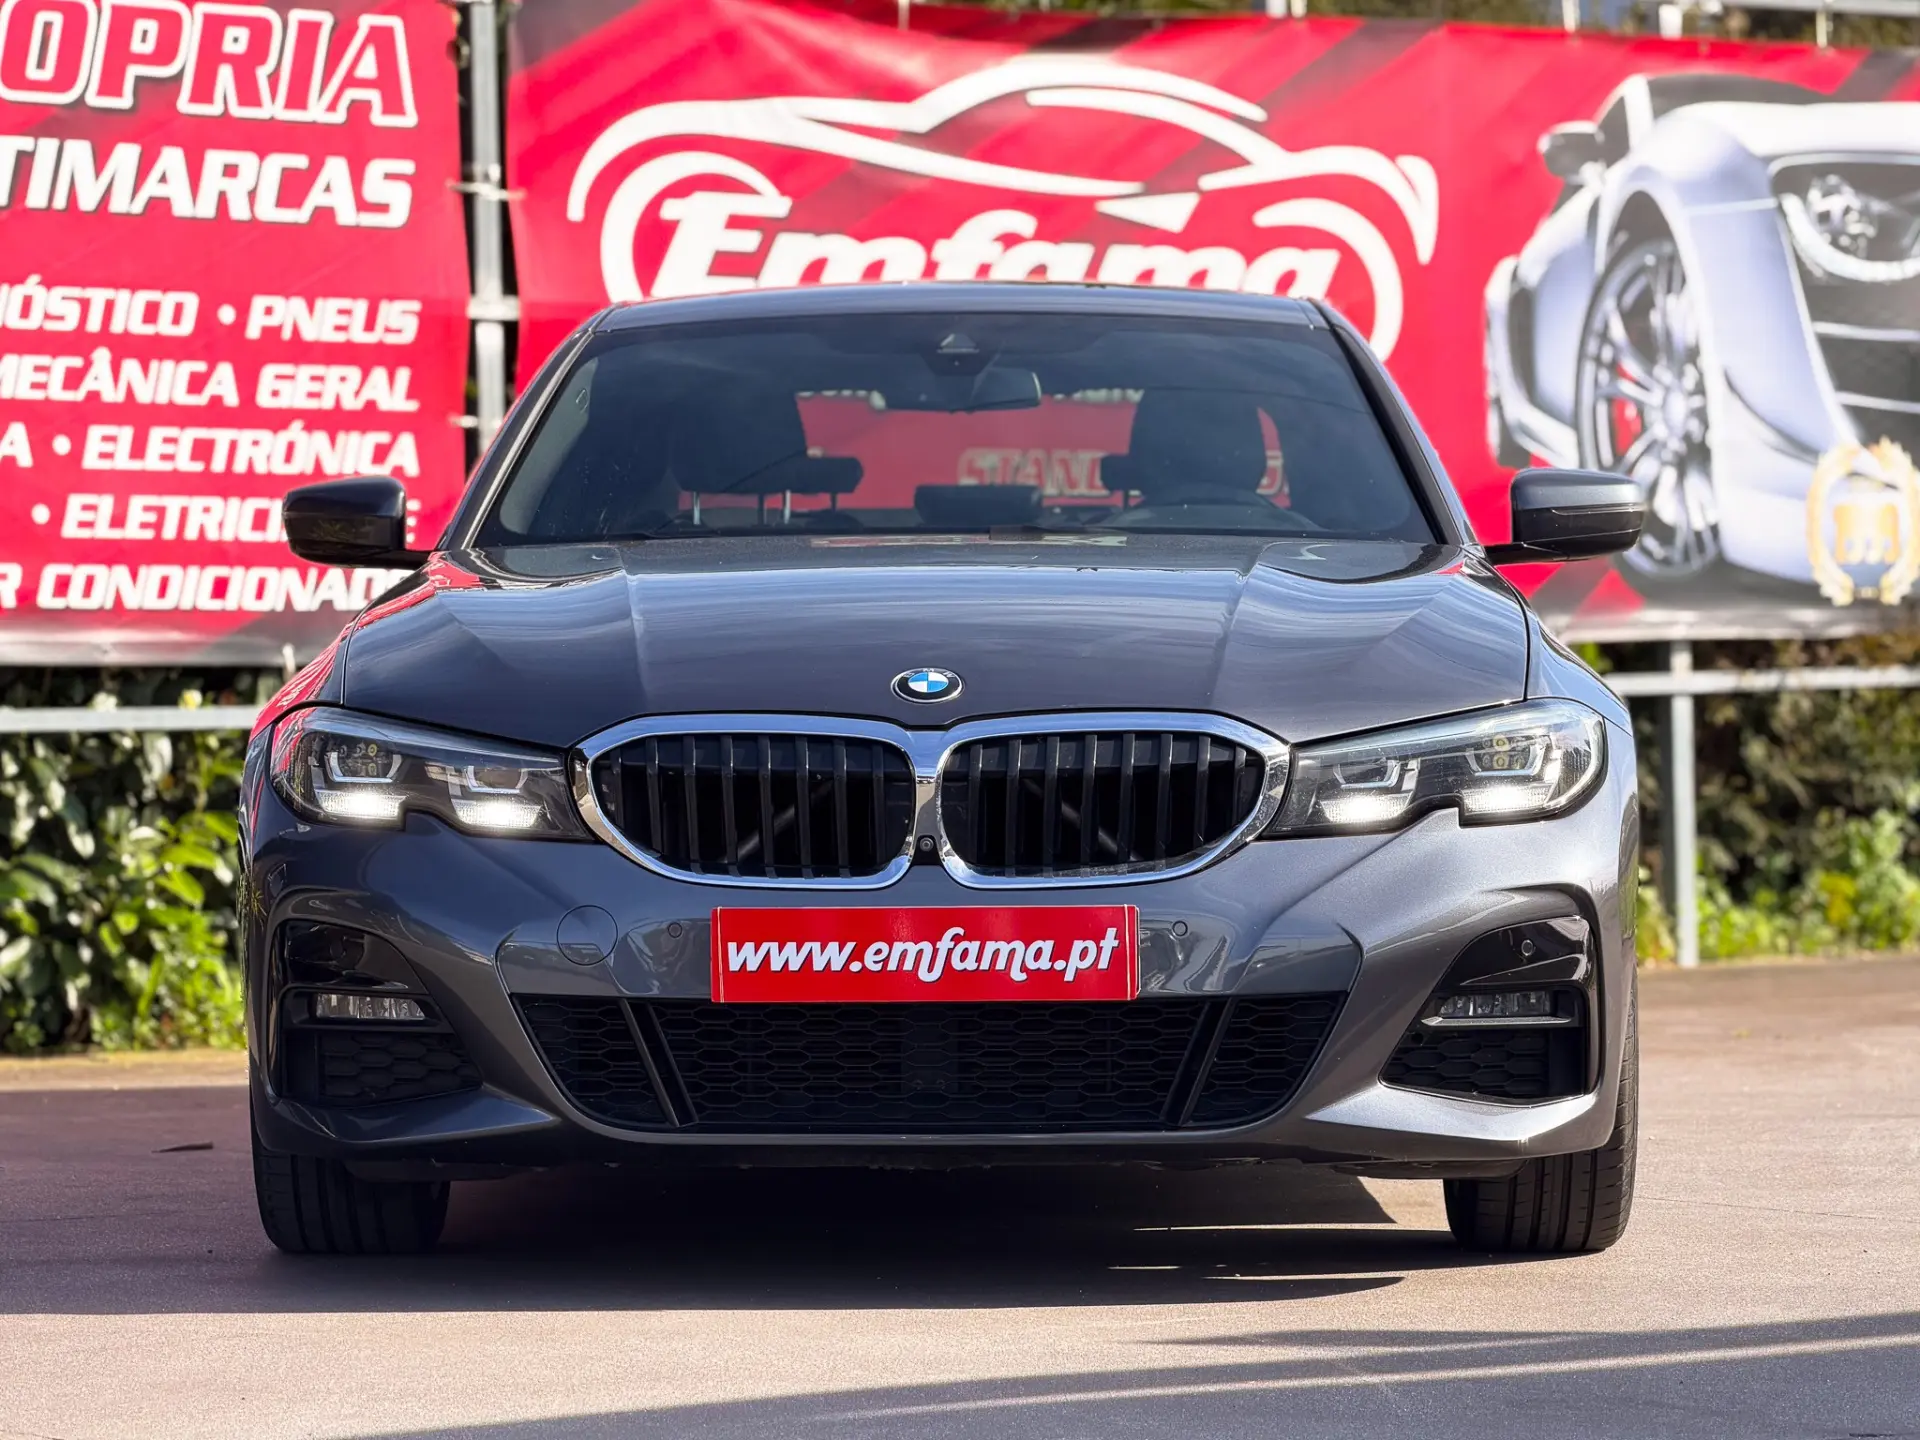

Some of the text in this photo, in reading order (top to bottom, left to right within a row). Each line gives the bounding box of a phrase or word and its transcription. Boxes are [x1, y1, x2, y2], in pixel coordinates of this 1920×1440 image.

[0, 0, 419, 129] OPRIA
[650, 190, 1342, 299] Emfama
[245, 294, 422, 345] PNEUS
[255, 362, 420, 412] GERAL
[81, 420, 420, 475] ELECTRÓNICA
[36, 563, 416, 613] CONDICIONAD
[727, 926, 1119, 982] www.emfama.pt
